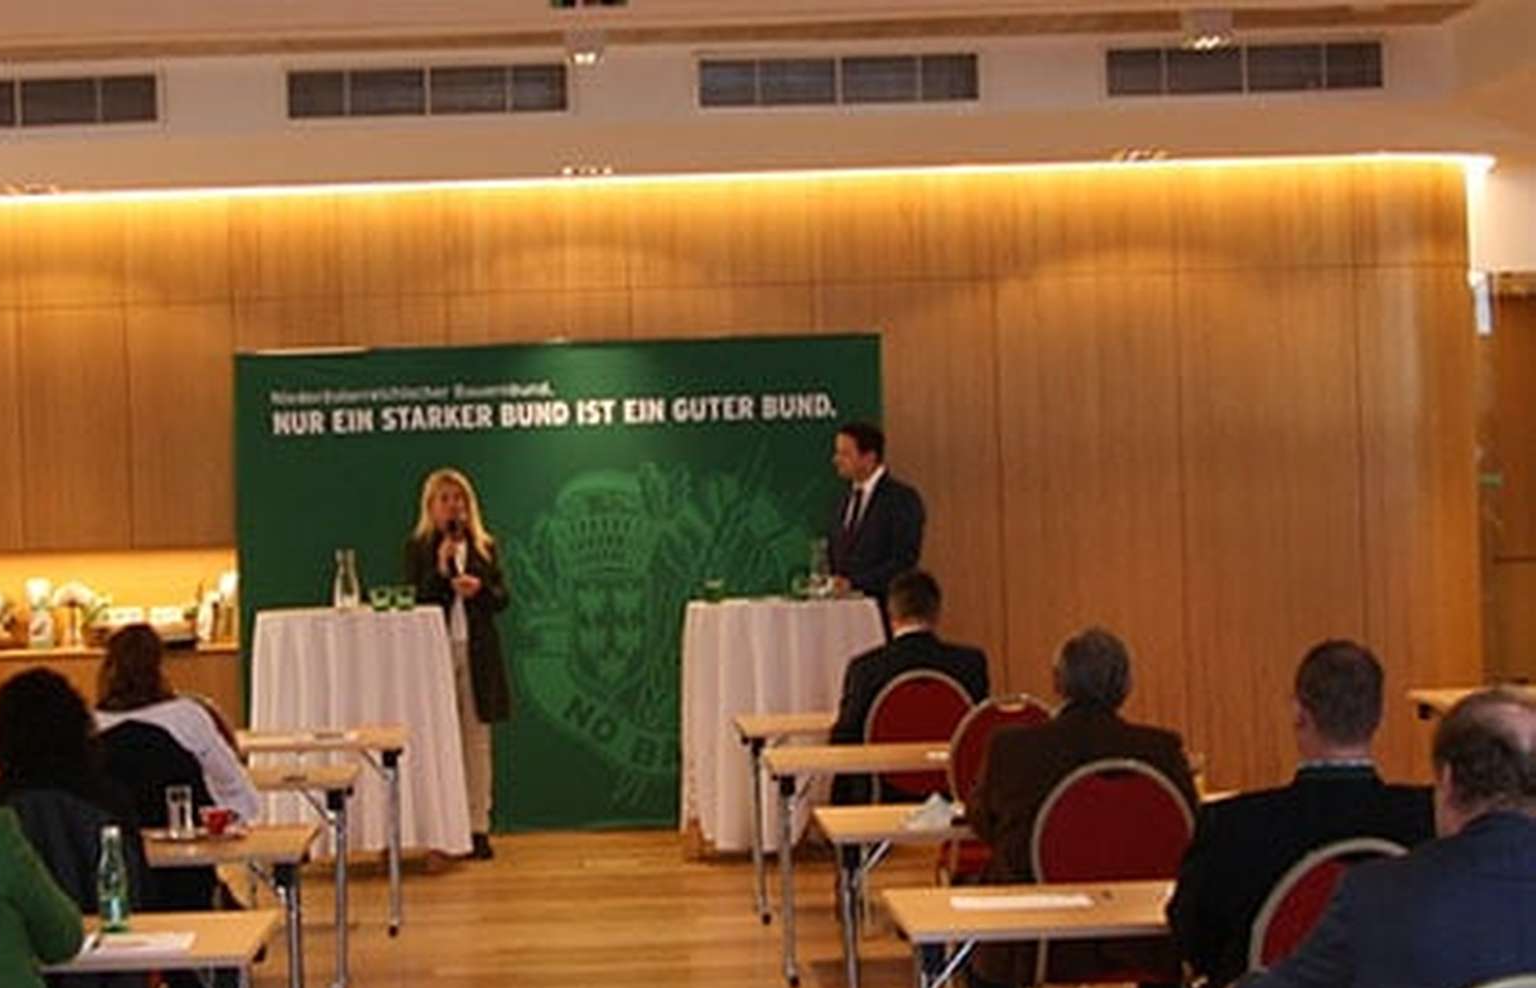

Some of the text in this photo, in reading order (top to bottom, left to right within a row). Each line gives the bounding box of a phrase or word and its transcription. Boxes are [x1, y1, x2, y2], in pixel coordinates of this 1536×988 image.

[273, 394, 837, 434] NUR EIN STARKER BUND IST EIN GUTER BUND.
